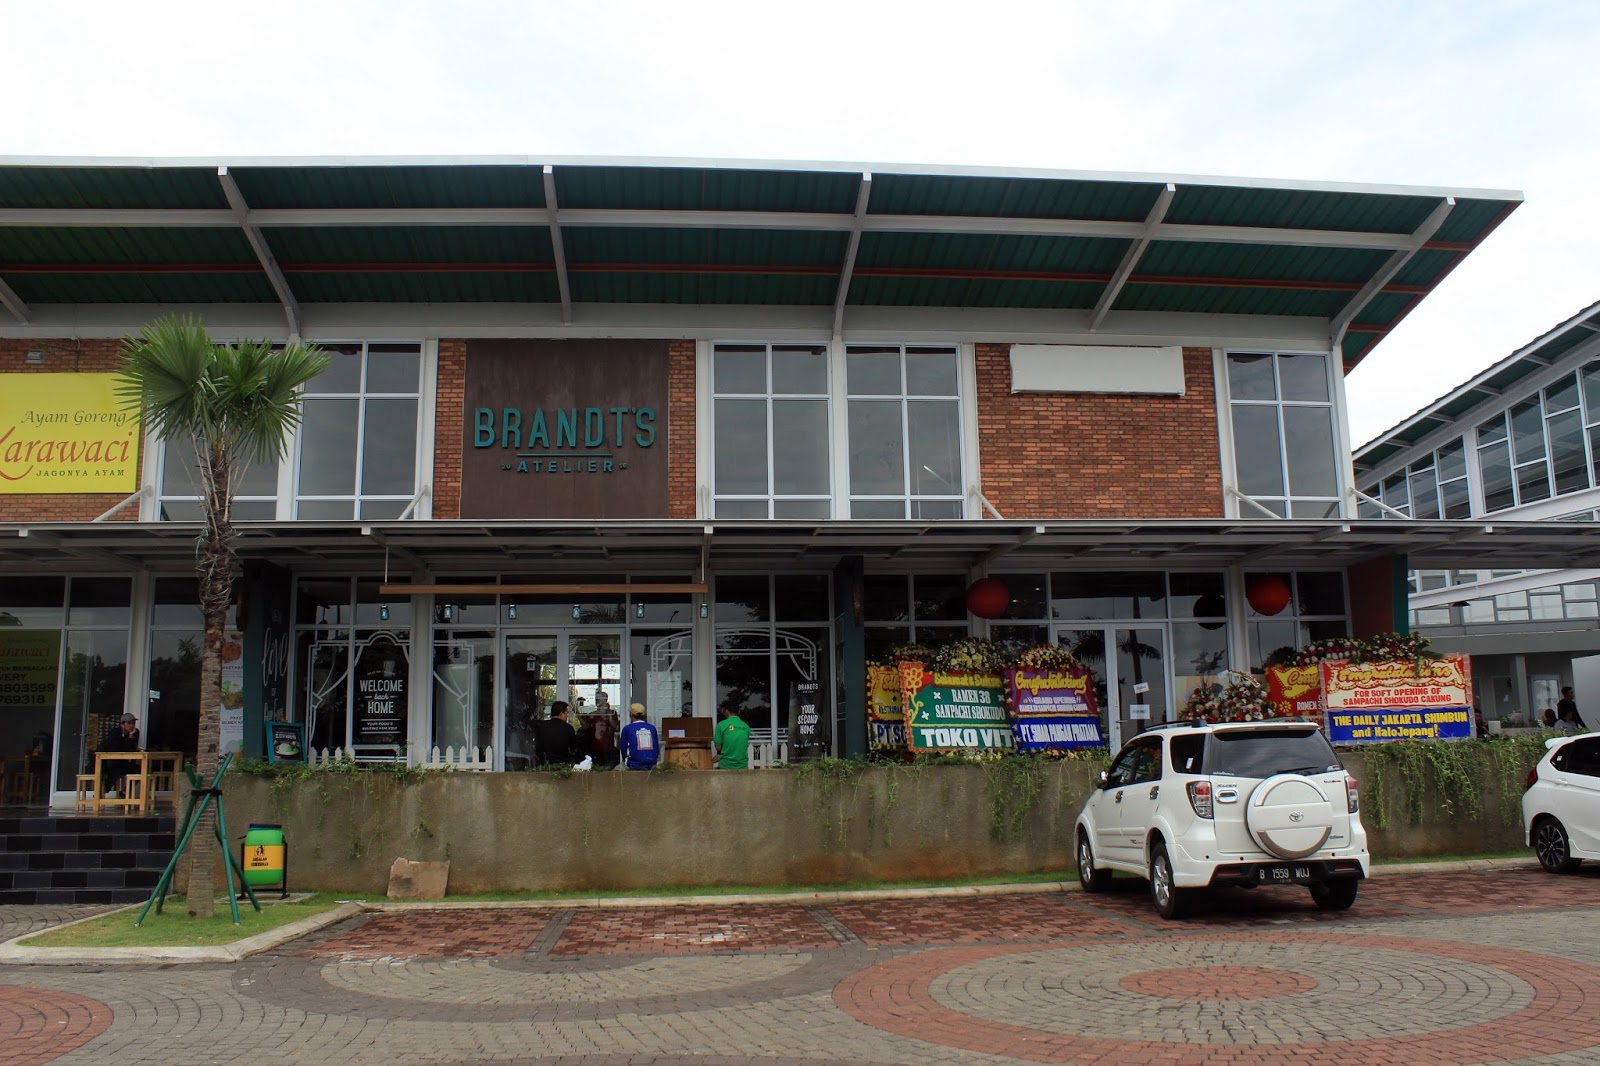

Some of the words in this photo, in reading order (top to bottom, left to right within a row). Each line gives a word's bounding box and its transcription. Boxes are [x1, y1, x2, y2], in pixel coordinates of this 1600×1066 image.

[20, 410, 69, 428] Ayam
[73, 410, 127, 427] Goreng
[474, 407, 656, 448] BRANDT'S
[516, 460, 613, 473] ATELIER
[36, 469, 88, 477] JAGONYA
[360, 680, 403, 691] WELCOME
[951, 689, 979, 703] RAMEN
[979, 690, 991, 704] 38
[1354, 690, 1369, 698] FOR
[1394, 688, 1428, 696] OPENING
[1431, 687, 1442, 695] OF
[1343, 697, 1383, 706] SAMPACHI
[1384, 696, 1419, 704] SHOKUDO
[1421, 694, 1451, 703] CAKUNG
[368, 701, 394, 713] HOME
[801, 704, 815, 714] YOUR
[935, 704, 971, 719] SANPACHI
[971, 706, 1006, 720] SHOKUDO
[798, 715, 818, 725] SECOND
[1333, 716, 1351, 726] THE
[1353, 714, 1379, 726] DAILY
[1381, 713, 1422, 724] JAKARTA
[1425, 711, 1467, 723] SHIMBUN
[800, 725, 815, 735] HOME
[1352, 727, 1371, 738] and
[1375, 724, 1439, 739] HaloJepang!
[921, 728, 978, 747] TOKO
[1260, 869, 1265, 879] B
[1272, 868, 1289, 879] 1559
[1295, 867, 1310, 878] WUJ
